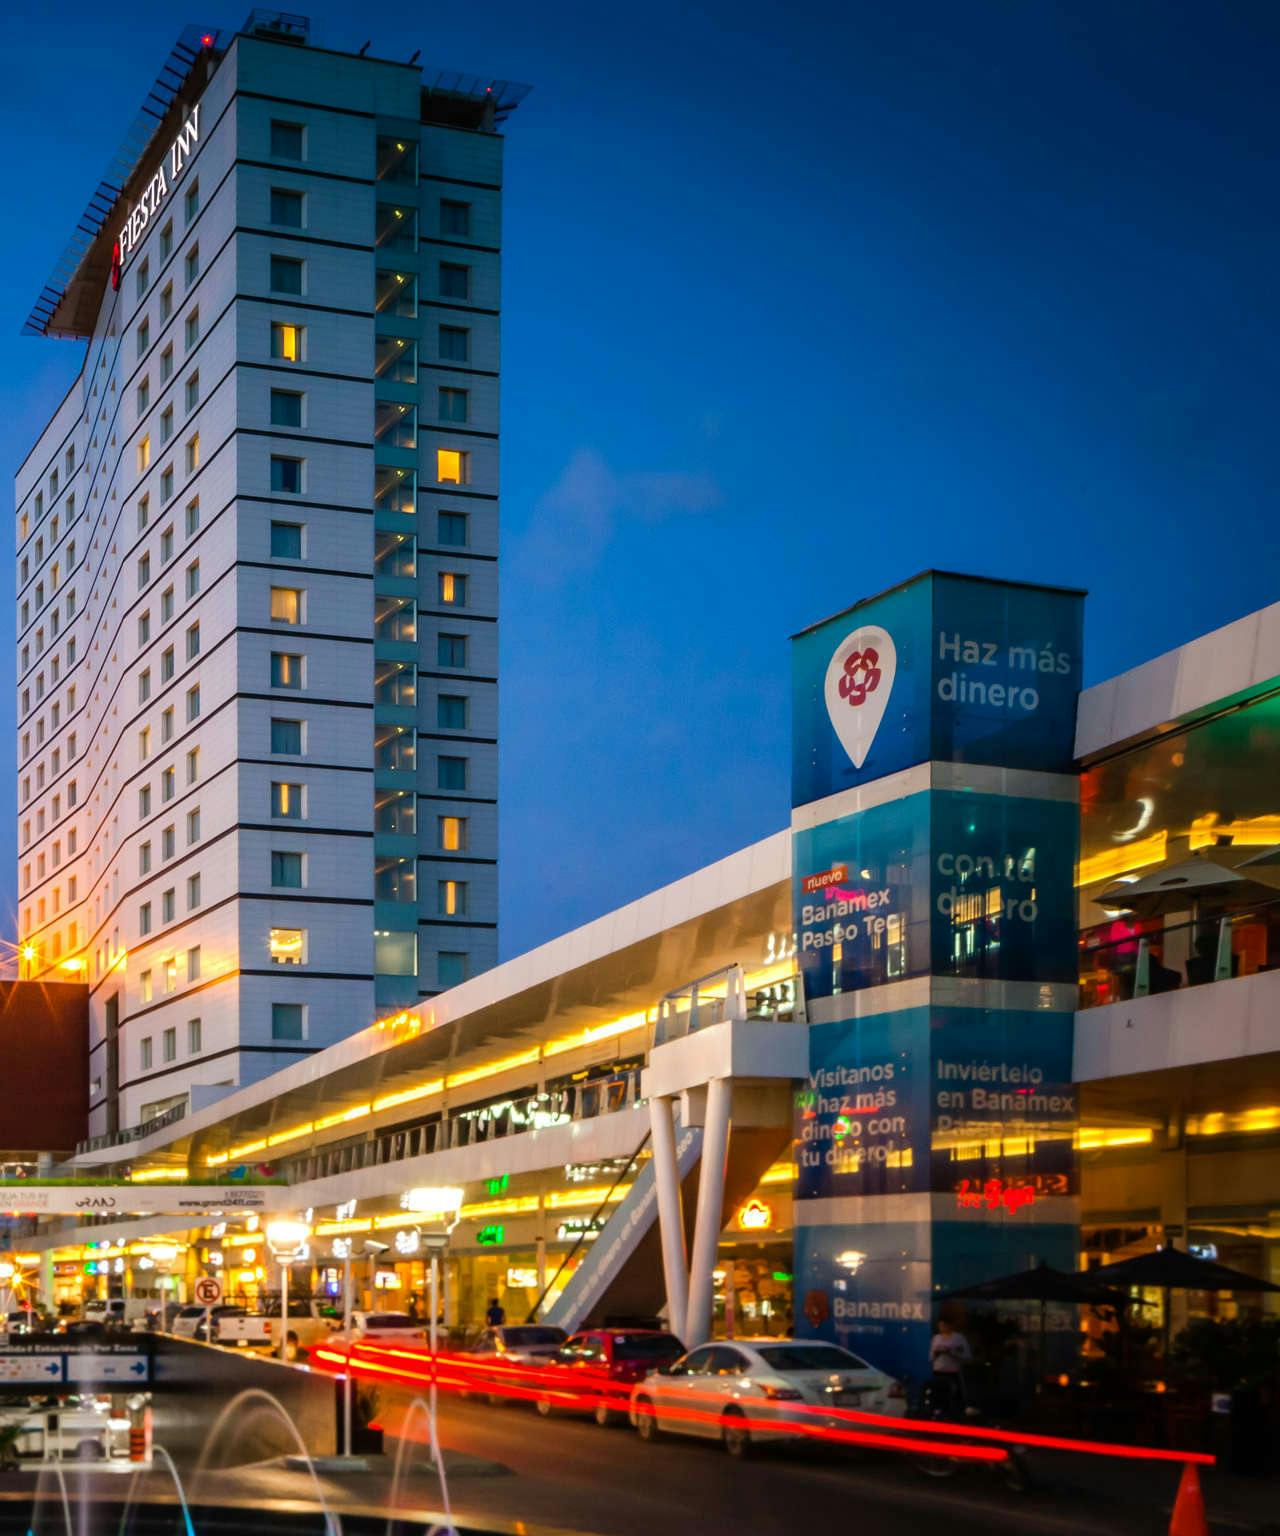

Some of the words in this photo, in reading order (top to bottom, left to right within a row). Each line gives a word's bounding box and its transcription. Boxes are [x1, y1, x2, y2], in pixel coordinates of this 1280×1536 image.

[119, 165, 168, 266] FIESTA
[170, 103, 200, 181] INN
[939, 631, 999, 667] Haz
[1008, 641, 1071, 674] más
[937, 671, 1040, 711] dinero
[937, 852, 995, 879] con
[807, 870, 843, 890] nuevo
[802, 887, 891, 927] Banamex
[802, 923, 858, 952] Paseo
[863, 913, 900, 936] Tec
[937, 1058, 1043, 1084] Inviértelo
[818, 1093, 851, 1114] haz
[856, 1085, 897, 1110] más
[937, 1090, 964, 1109] en
[971, 1088, 1075, 1113] Banamex
[802, 1121, 863, 1142] dino
[867, 1115, 906, 1136] con
[802, 1149, 821, 1168] tu
[833, 1297, 924, 1319] Banamex
